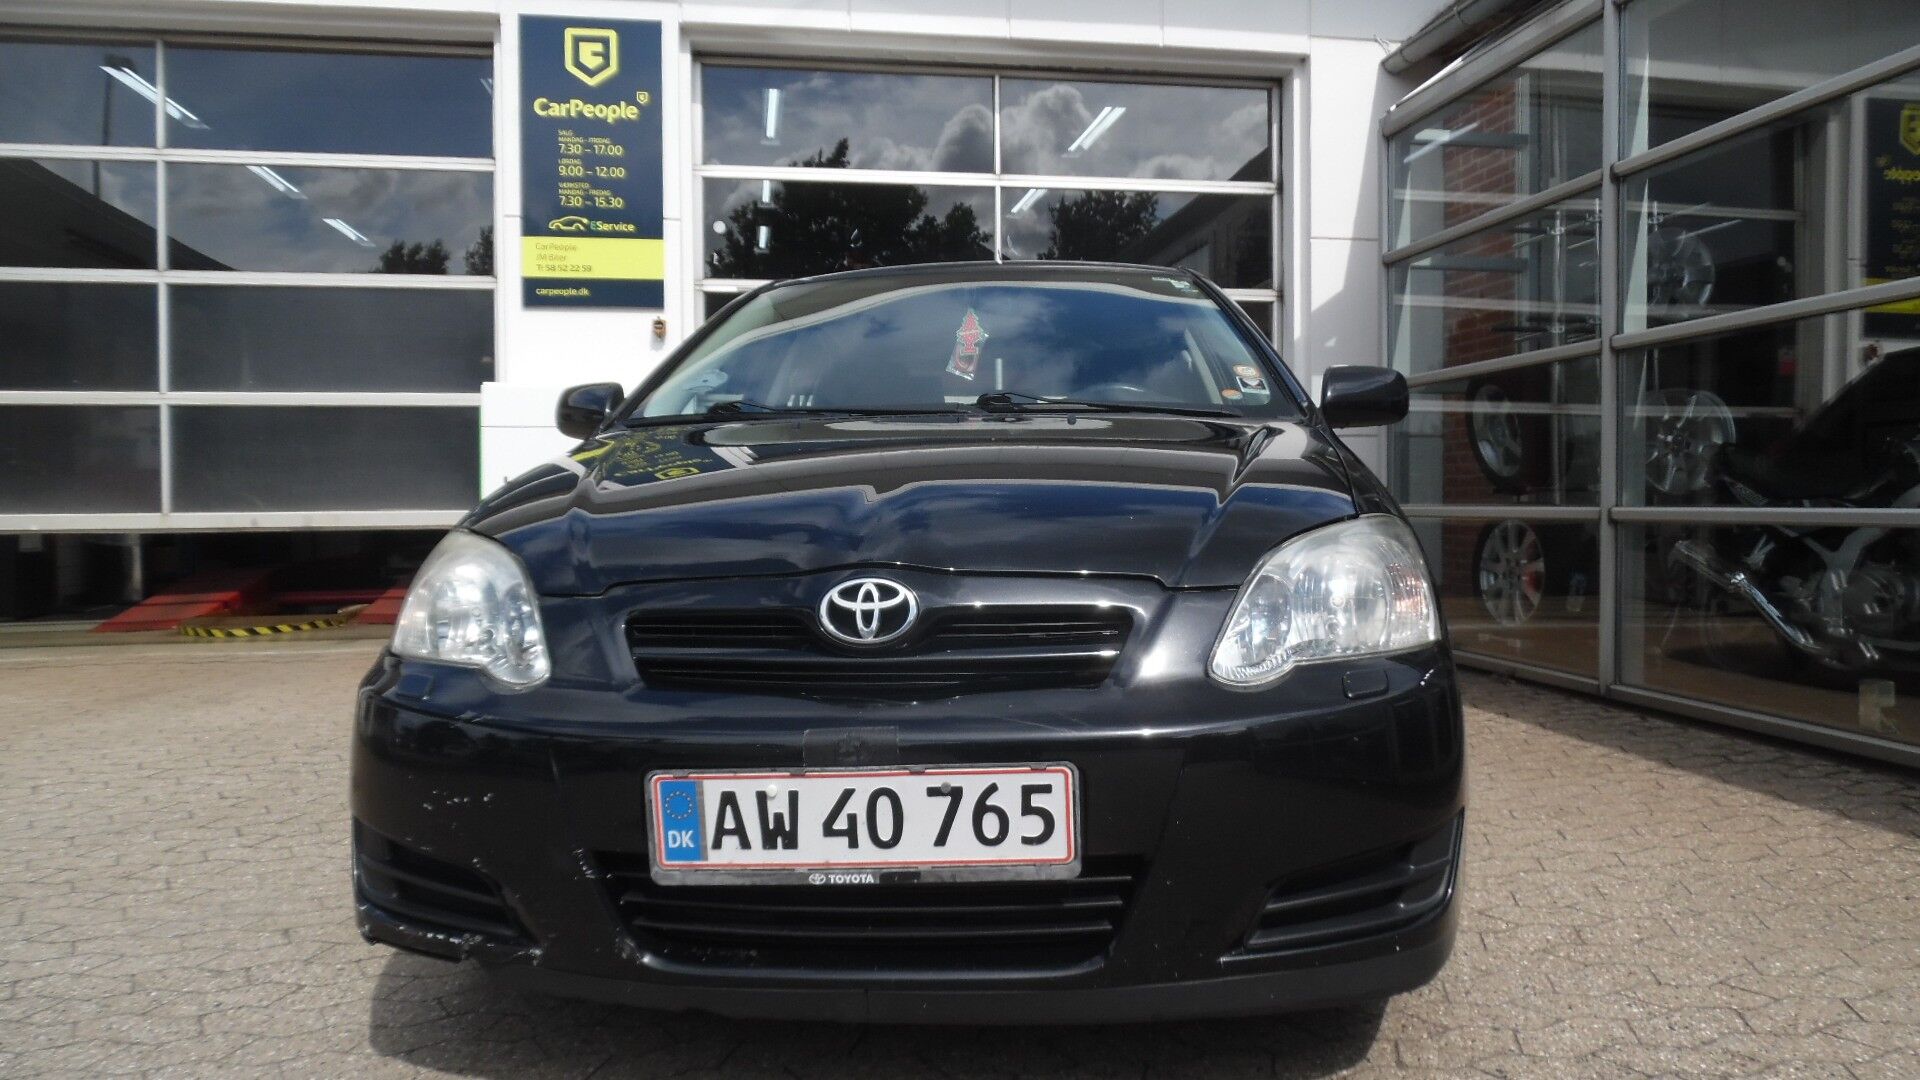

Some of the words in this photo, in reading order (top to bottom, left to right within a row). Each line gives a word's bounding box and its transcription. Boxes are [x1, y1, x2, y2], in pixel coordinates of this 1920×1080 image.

[533, 97, 640, 123] CarPeople
[558, 144, 582, 154] 7.30
[593, 145, 623, 155] 17.00
[558, 165, 583, 176] 9.00
[595, 167, 625, 177] 12.00
[559, 196, 582, 206] 7.30
[594, 197, 624, 207] 15.30
[535, 243, 578, 252] CarPeople
[535, 287, 589, 296] carpeople.dk
[711, 790, 799, 850] AW
[822, 787, 904, 849] 40
[926, 782, 1056, 847] 765
[667, 830, 694, 848] DK
[828, 874, 875, 884] TOYOTA
